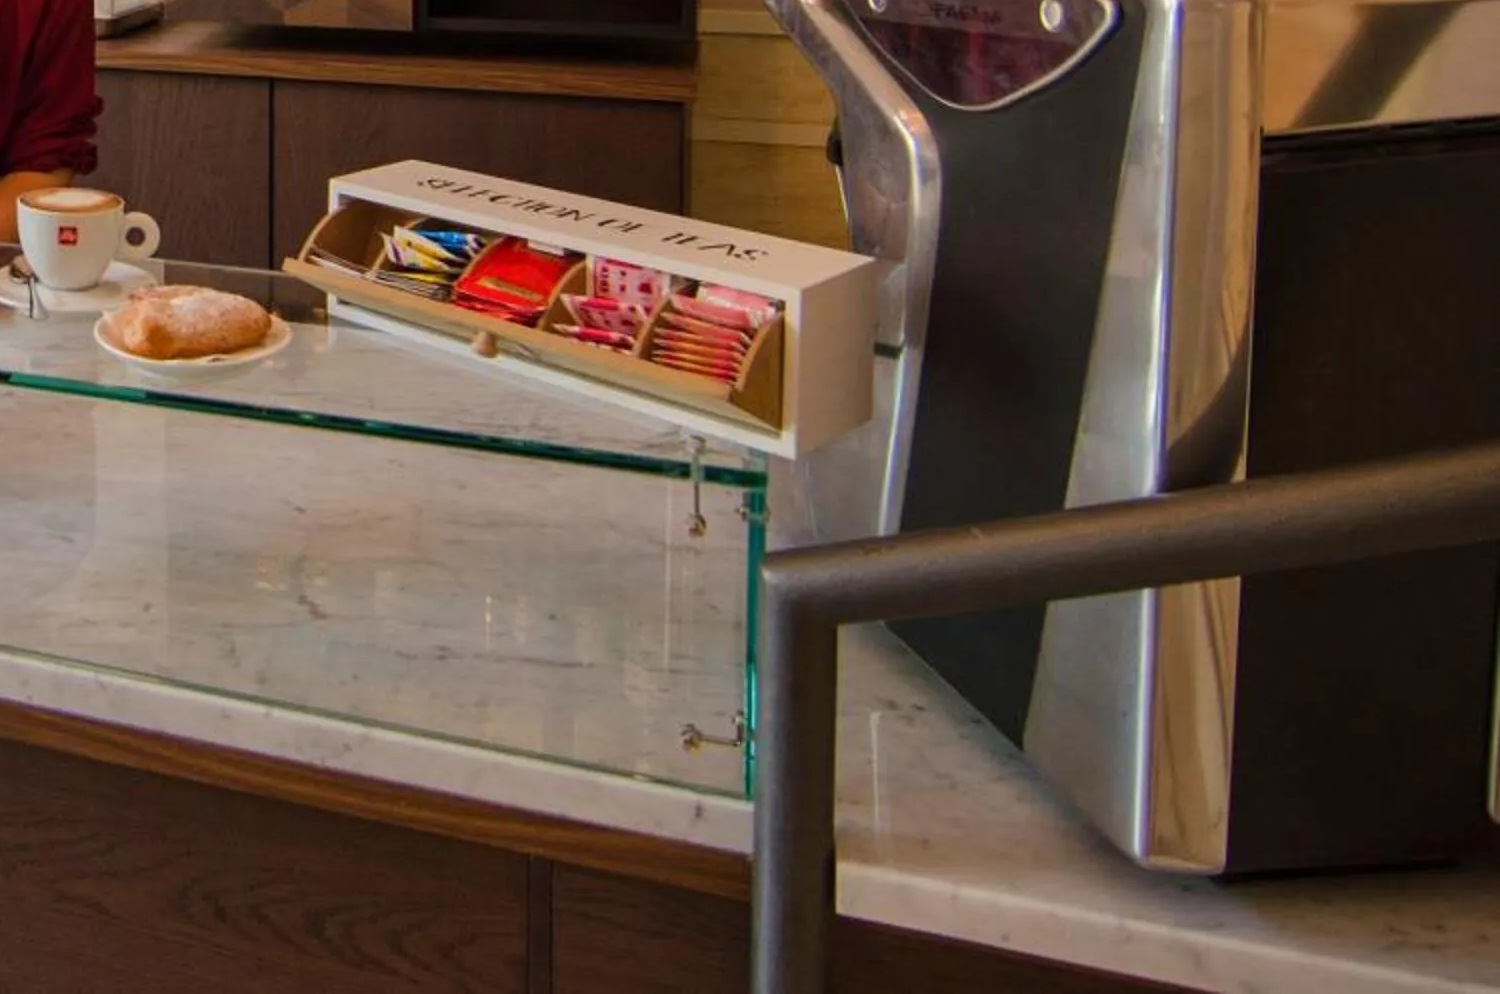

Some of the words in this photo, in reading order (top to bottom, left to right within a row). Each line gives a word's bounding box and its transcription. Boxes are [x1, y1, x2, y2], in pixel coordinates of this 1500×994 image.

[416, 175, 596, 222] SELECTION
[596, 218, 645, 234] OF
[660, 231, 770, 262] TEAS
